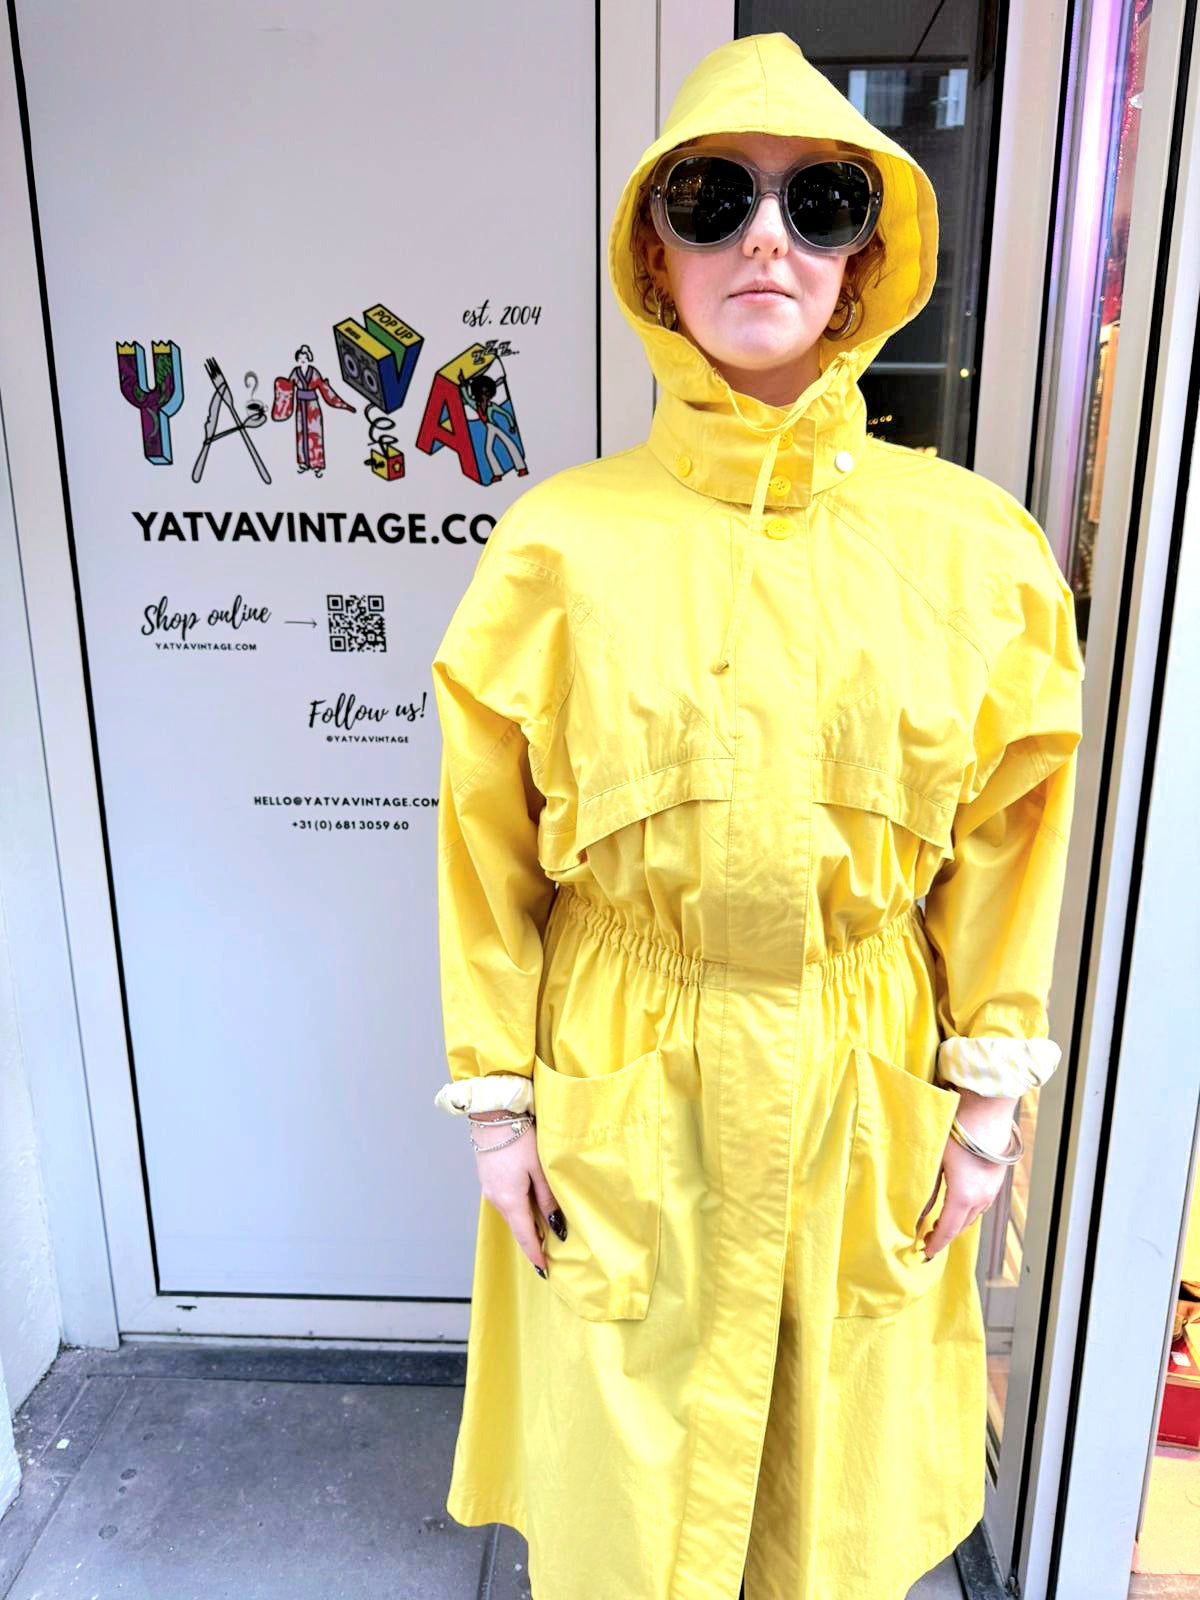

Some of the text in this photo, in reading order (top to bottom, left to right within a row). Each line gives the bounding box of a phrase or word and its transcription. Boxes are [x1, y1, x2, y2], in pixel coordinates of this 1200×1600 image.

[373, 309, 413, 341] POP UP
[463, 300, 542, 328] est. 2004
[132, 512, 498, 545] YATVAVINTAGE.CO
[141, 594, 273, 640] Shop online
[155, 642, 258, 651] YATVAVINTAGE.COM
[308, 692, 428, 730] Follow us!
[325, 735, 410, 744] @YATVAVINTAGE
